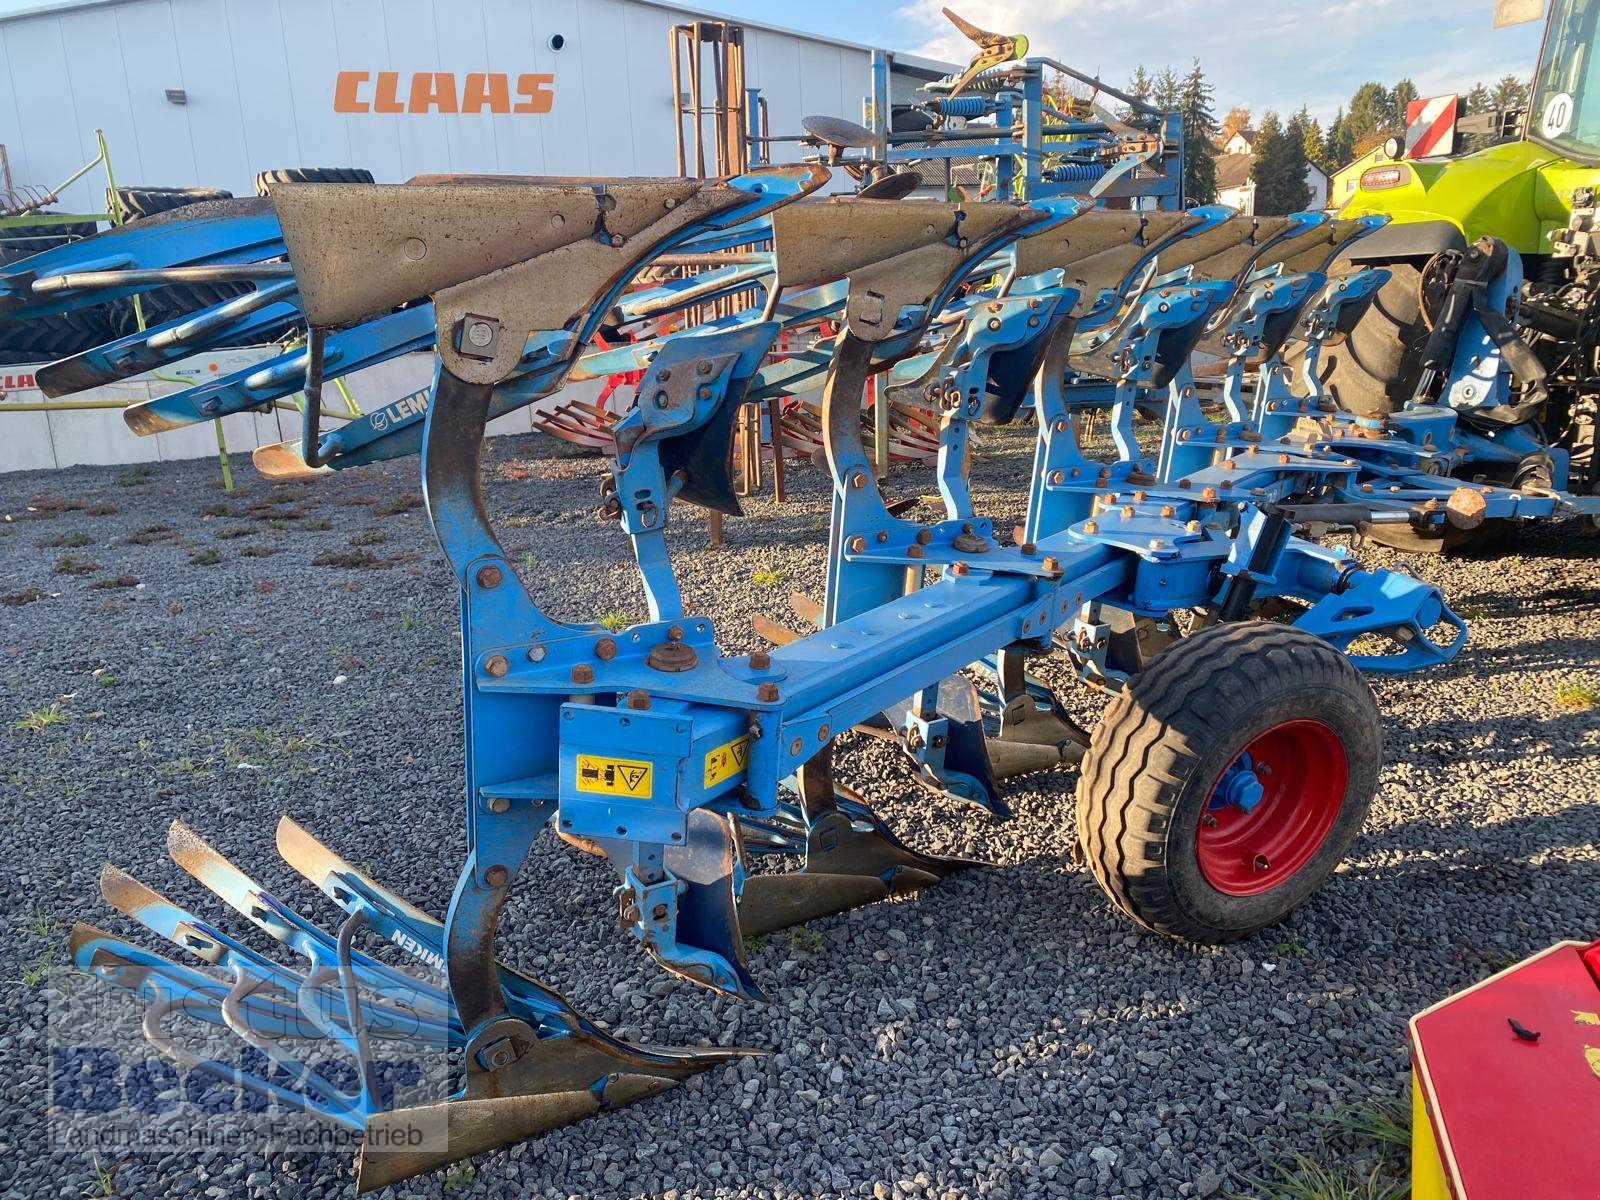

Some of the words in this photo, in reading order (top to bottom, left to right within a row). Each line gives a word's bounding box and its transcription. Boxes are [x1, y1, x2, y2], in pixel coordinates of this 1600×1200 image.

[333, 71, 555, 114] CLAAS
[1547, 102, 1567, 130] 40
[391, 928, 446, 972] MKEN
